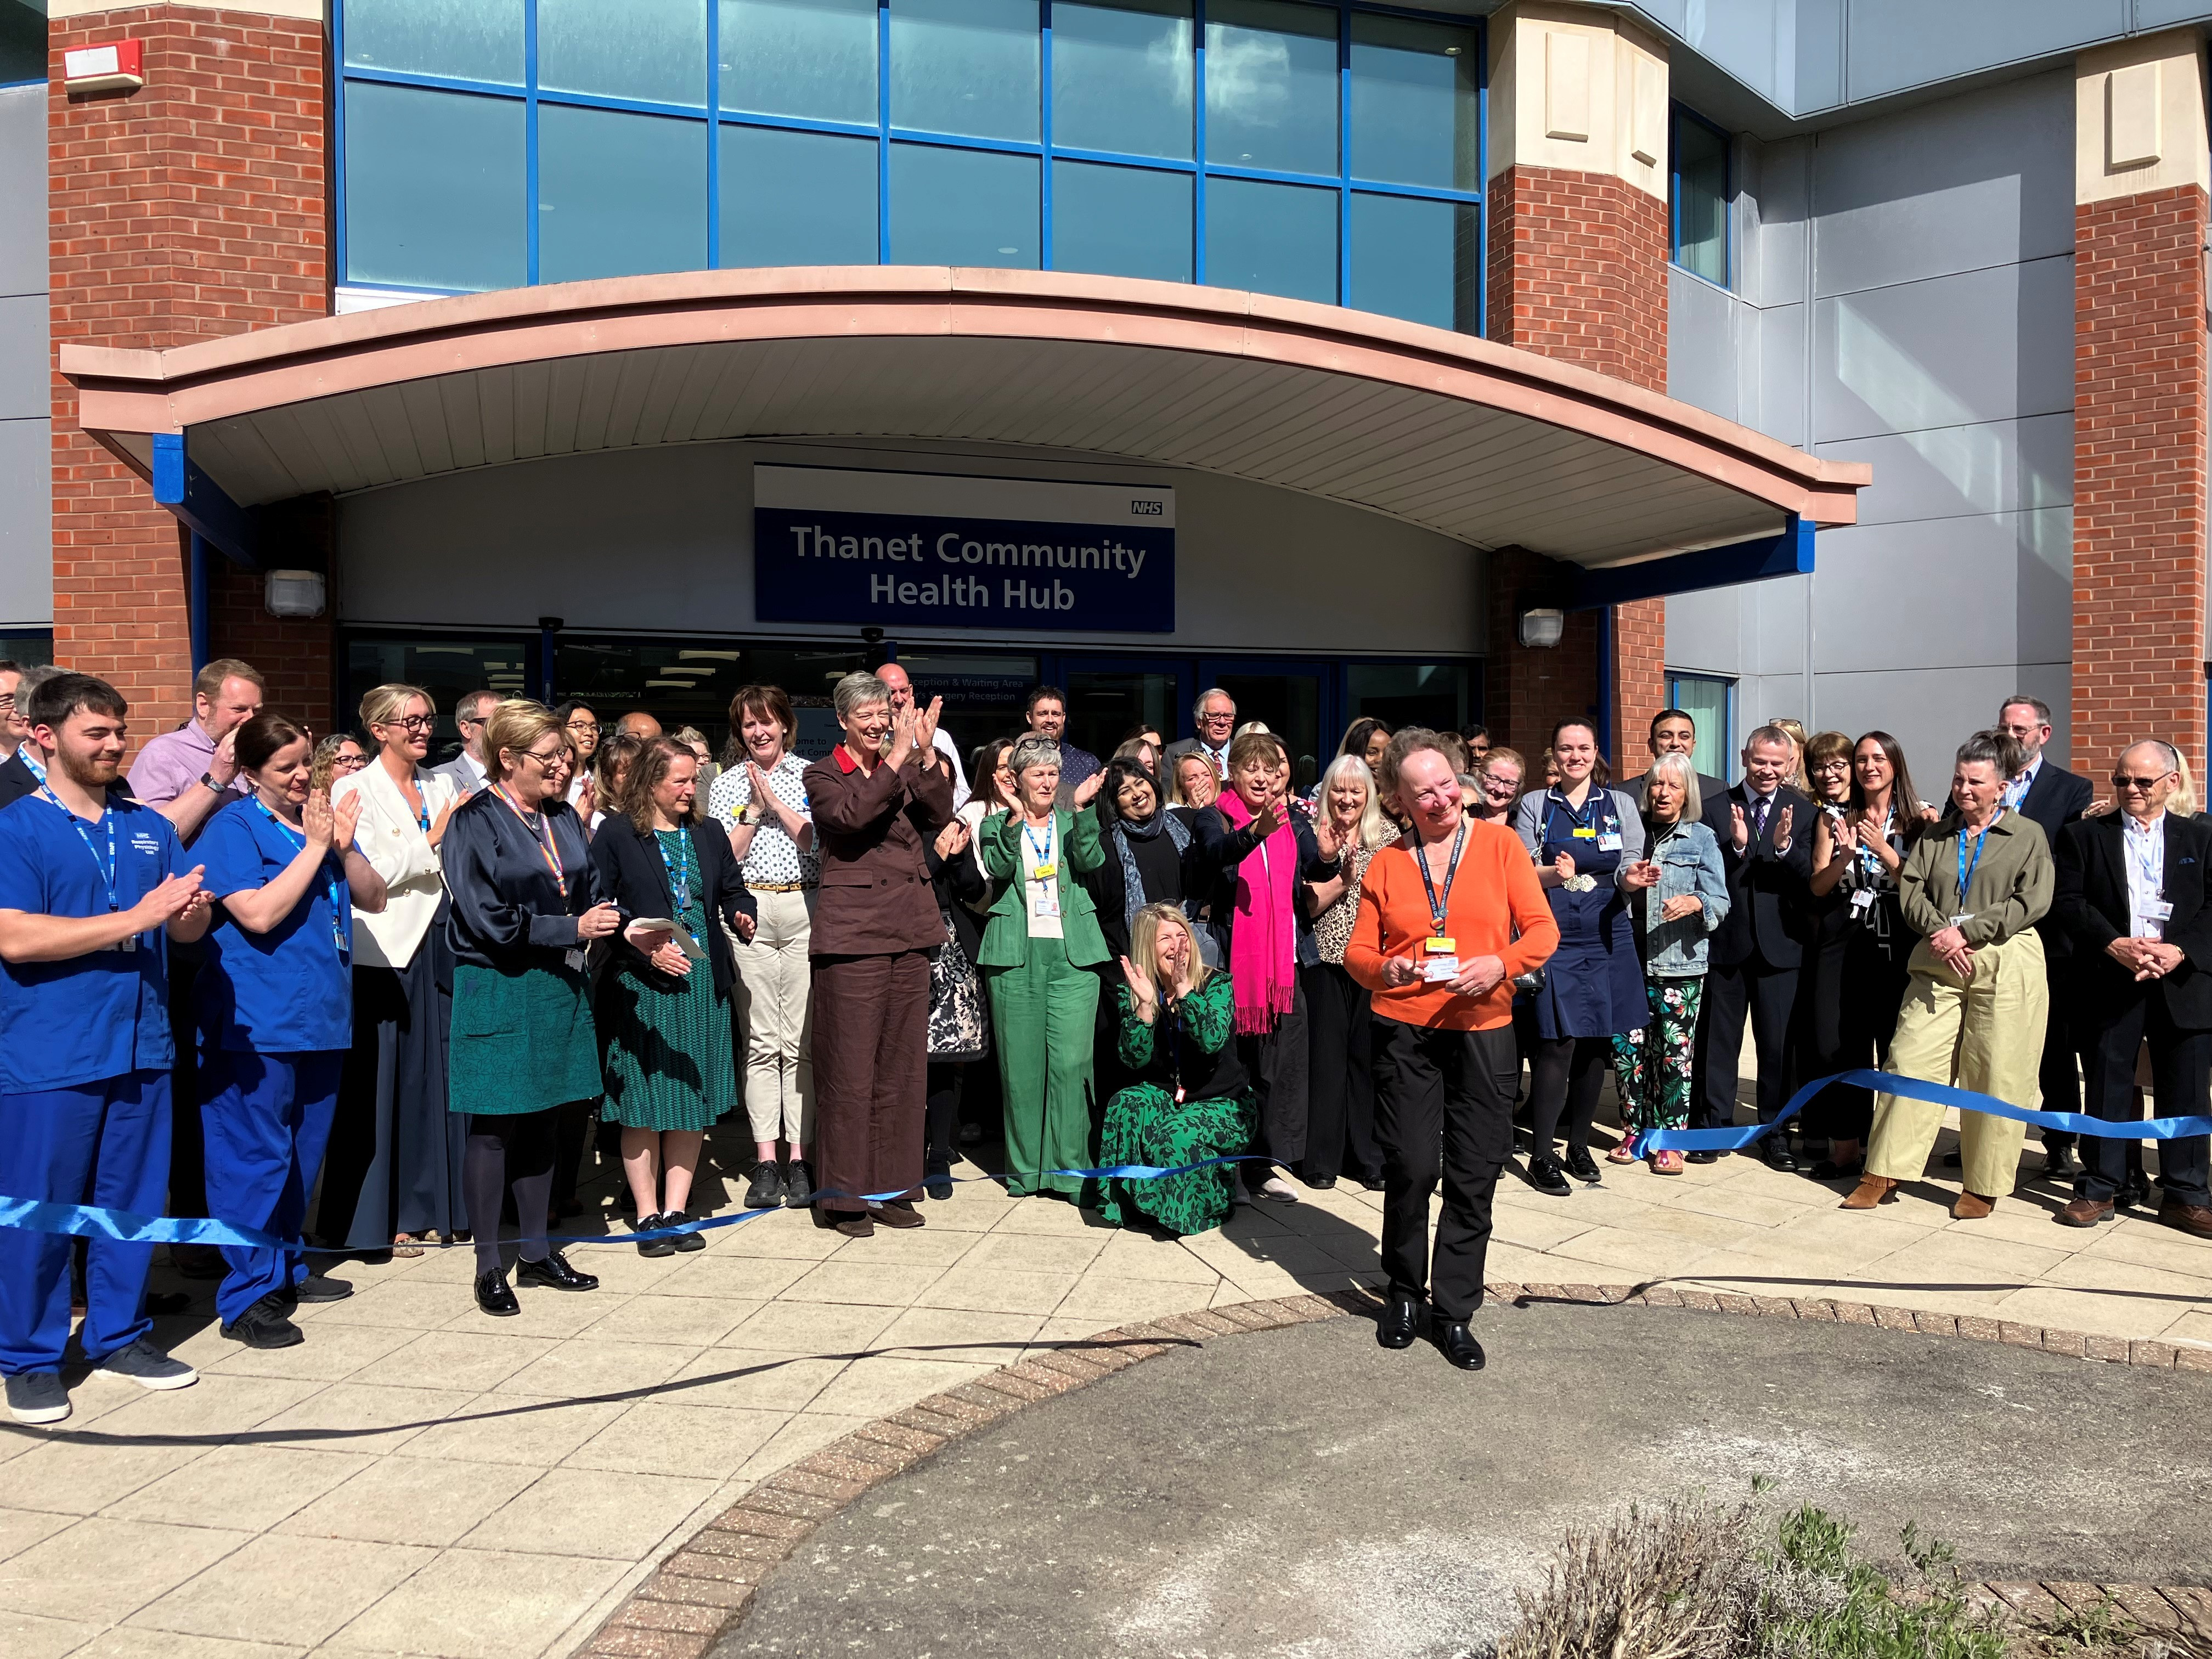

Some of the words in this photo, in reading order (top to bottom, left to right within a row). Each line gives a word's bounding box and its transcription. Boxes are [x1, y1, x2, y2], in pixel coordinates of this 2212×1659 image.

[1133, 501, 1162, 515] NHS
[790, 526, 923, 562] Thanet
[936, 533, 1146, 578] Community
[871, 573, 989, 607] Health
[1004, 579, 1074, 610] Hub
[952, 678, 959, 686] &
[962, 678, 999, 689] Waiting
[1002, 679, 1023, 687] Area
[969, 691, 1015, 702] Reception
[808, 748, 833, 757] Comm
[1451, 841, 1462, 865] VOLUNTEER
